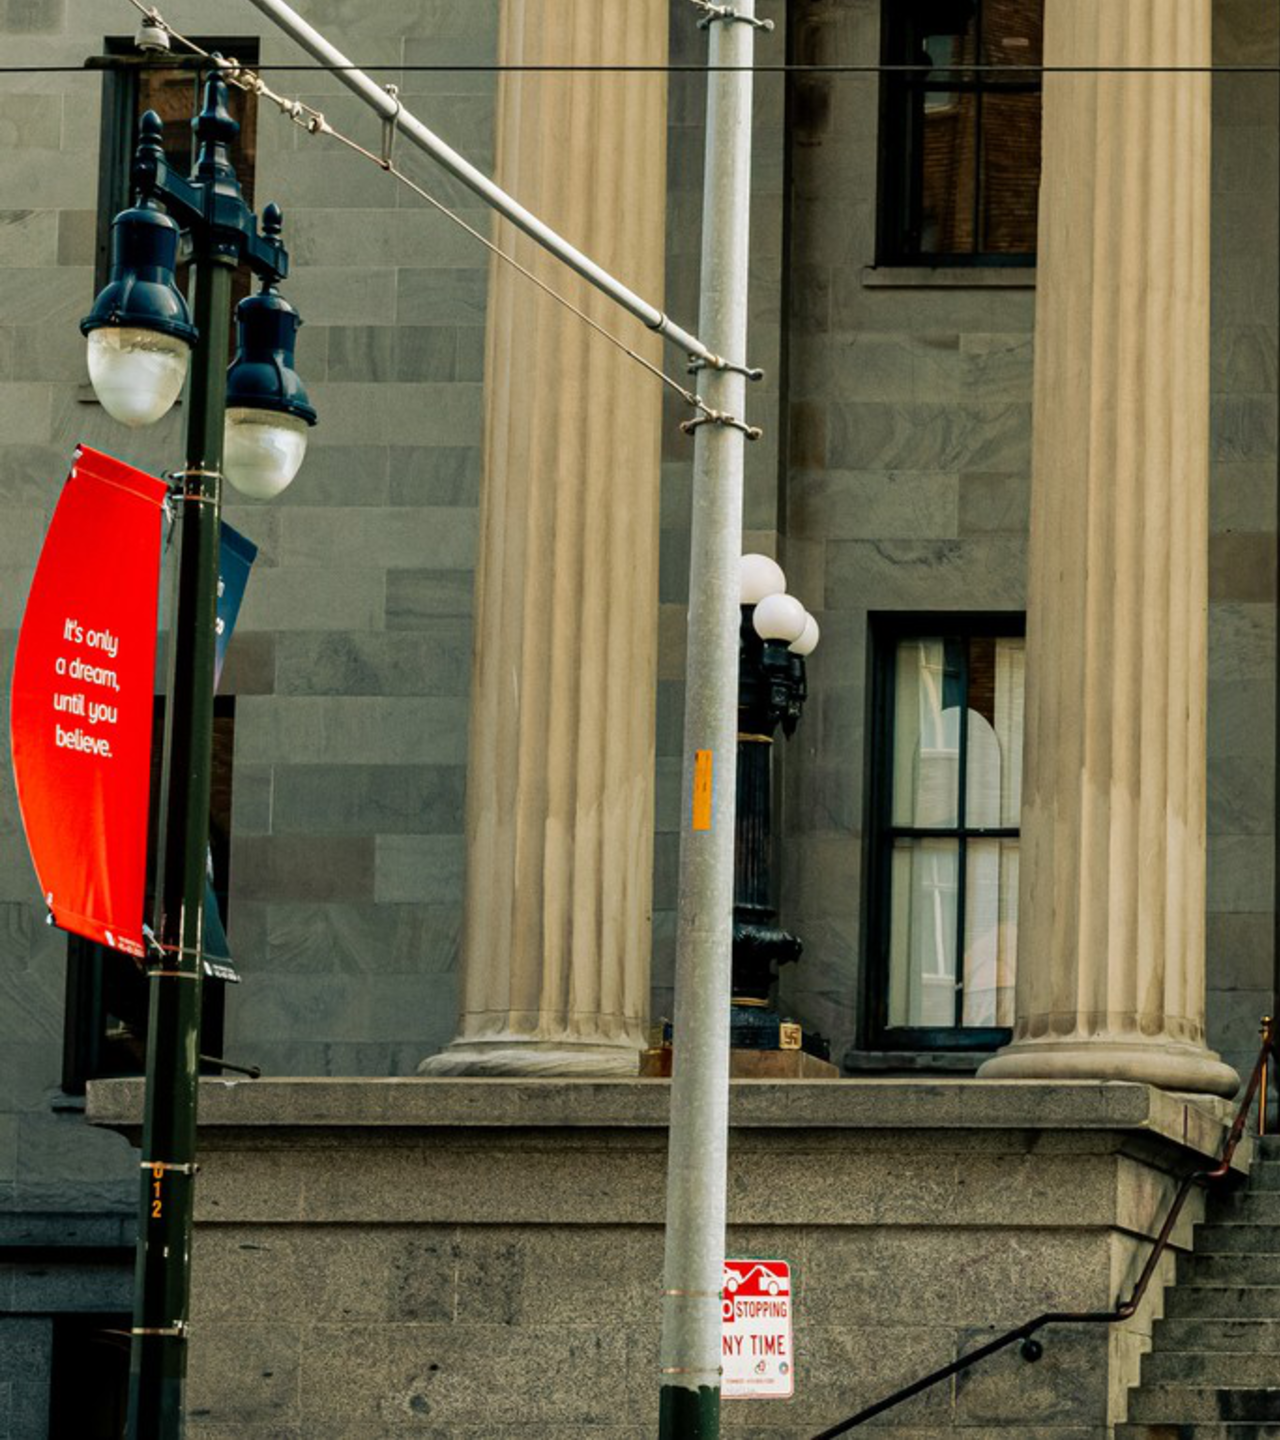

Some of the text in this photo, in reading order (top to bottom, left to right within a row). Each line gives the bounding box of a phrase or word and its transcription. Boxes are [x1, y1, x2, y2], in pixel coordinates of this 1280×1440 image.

[63, 618, 119, 658] It's only
[55, 656, 121, 692] a dream,
[53, 693, 118, 725] until you
[55, 724, 114, 758] believe.
[736, 1301, 788, 1318] STOPPING
[722, 1335, 785, 1356] NY TIME
